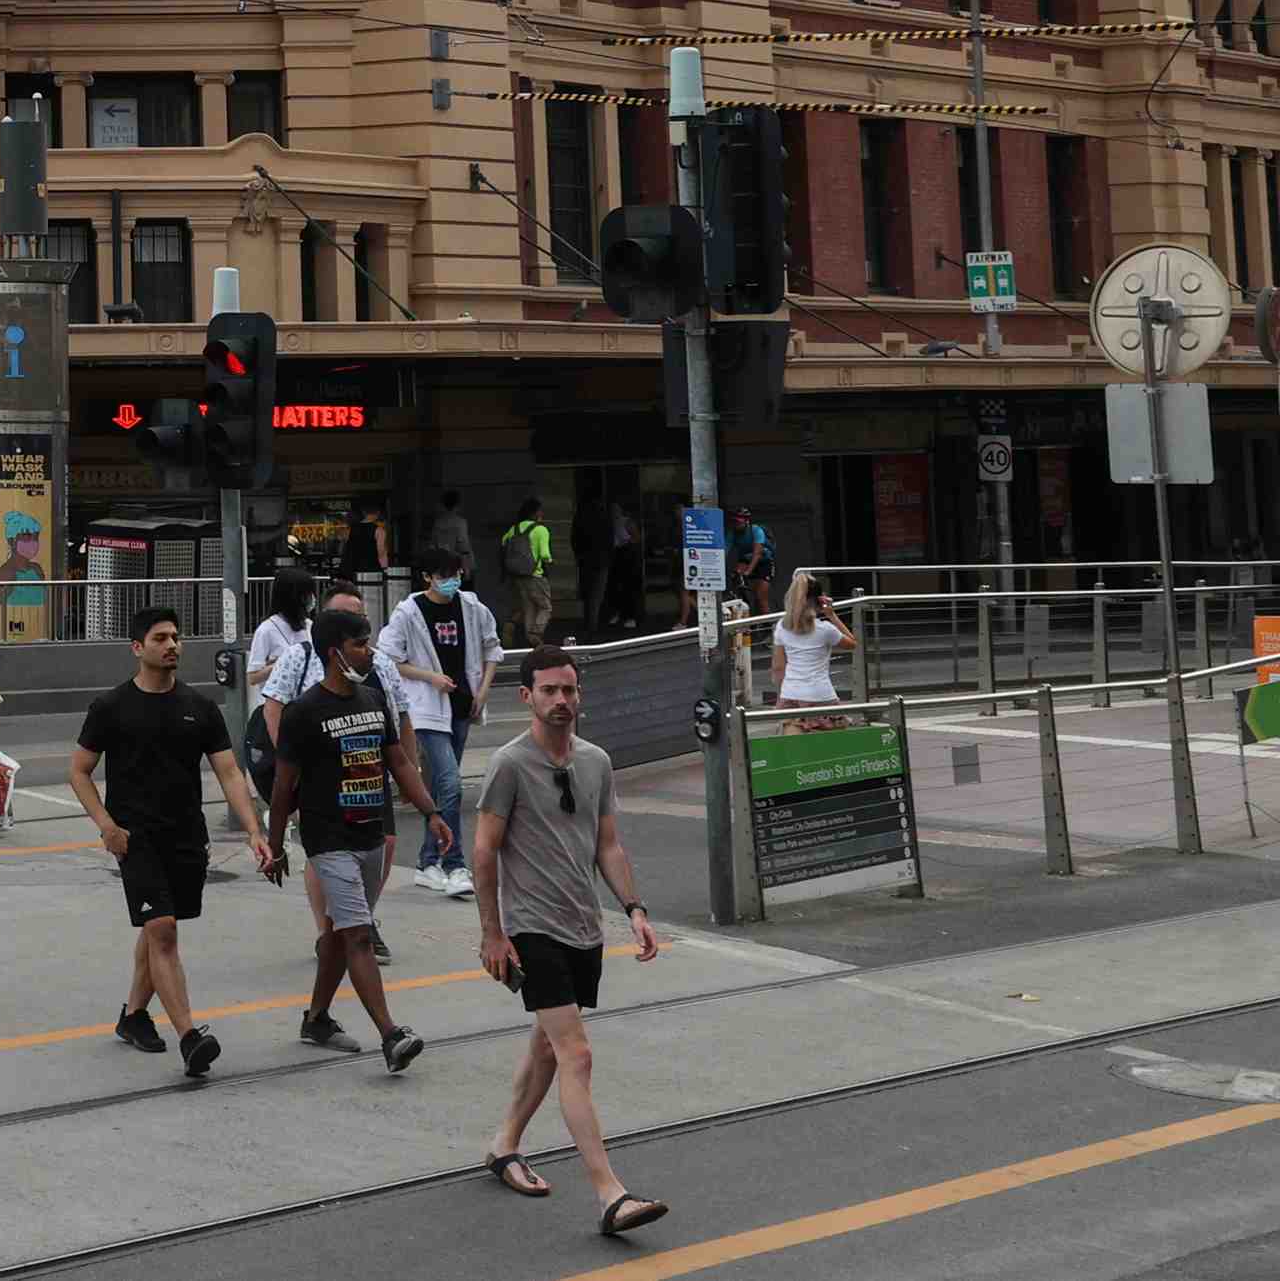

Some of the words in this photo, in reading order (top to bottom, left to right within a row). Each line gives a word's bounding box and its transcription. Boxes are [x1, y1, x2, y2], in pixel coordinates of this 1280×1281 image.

[969, 254, 1009, 263] FAIRWAY
[974, 304, 989, 312] ALL
[991, 302, 1015, 311] TIMES
[0, 454, 45, 463] WEAR
[983, 449, 1007, 466] 40
[1, 462, 44, 472] MASK
[14, 471, 45, 480] AND
[321, 720, 327, 732] I
[327, 715, 352, 731] ONLY
[351, 712, 377, 726] DRINK
[796, 768, 833, 786] Swanston
[834, 764, 845, 779] St
[845, 762, 861, 777] and
[861, 757, 890, 773] Flinders
